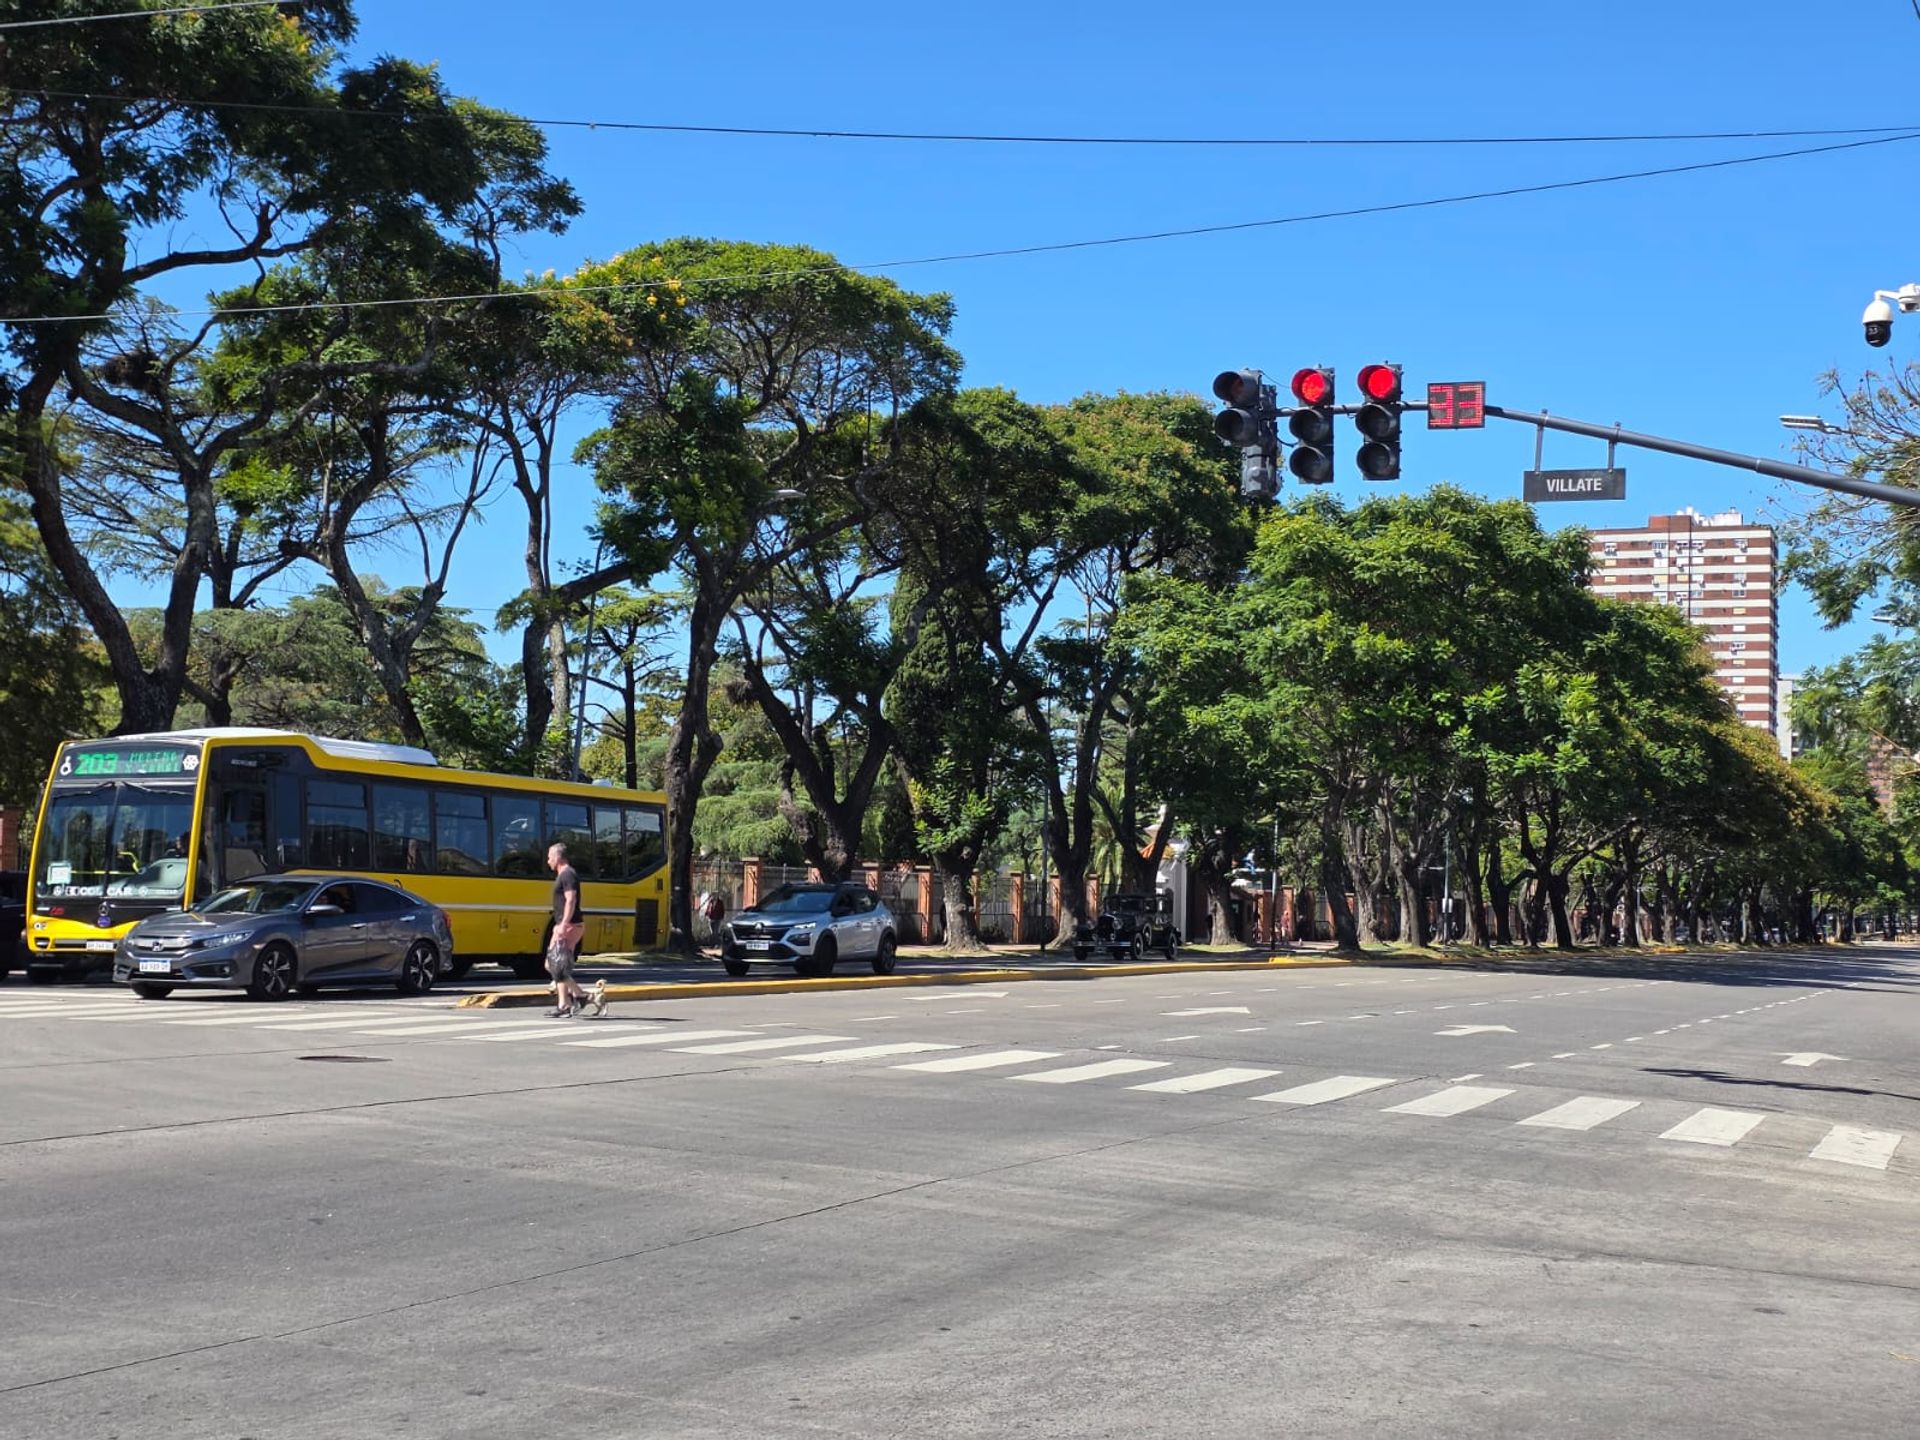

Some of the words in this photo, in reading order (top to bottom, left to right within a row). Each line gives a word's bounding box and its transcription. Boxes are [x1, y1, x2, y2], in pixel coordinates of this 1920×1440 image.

[1429, 384, 1482, 425] 33
[1546, 478, 1602, 492] VILLATE
[75, 752, 118, 775] 203
